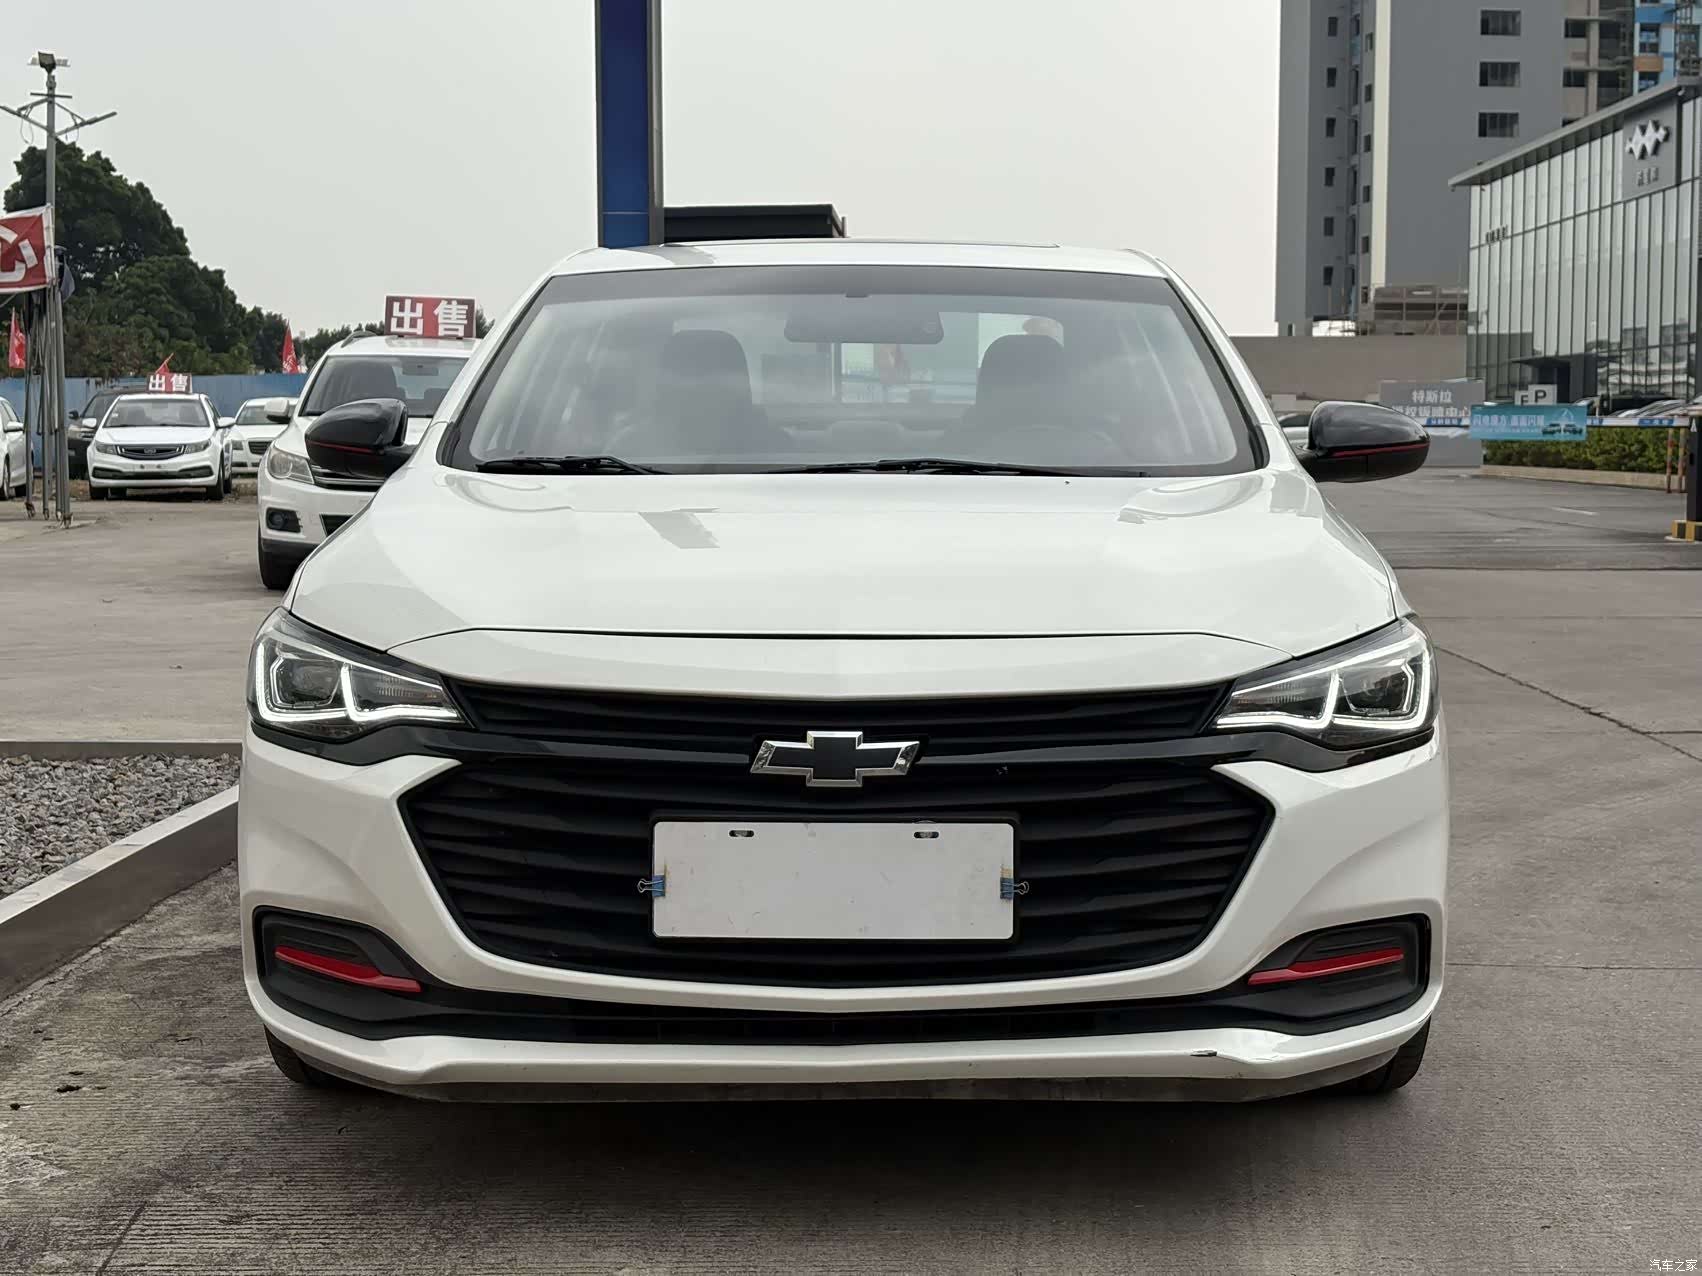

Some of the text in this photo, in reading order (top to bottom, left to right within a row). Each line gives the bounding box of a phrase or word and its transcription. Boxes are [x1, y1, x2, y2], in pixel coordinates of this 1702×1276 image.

[390, 299, 468, 336] 出售
[148, 373, 188, 392] 出售
[1535, 389, 1547, 403] P
